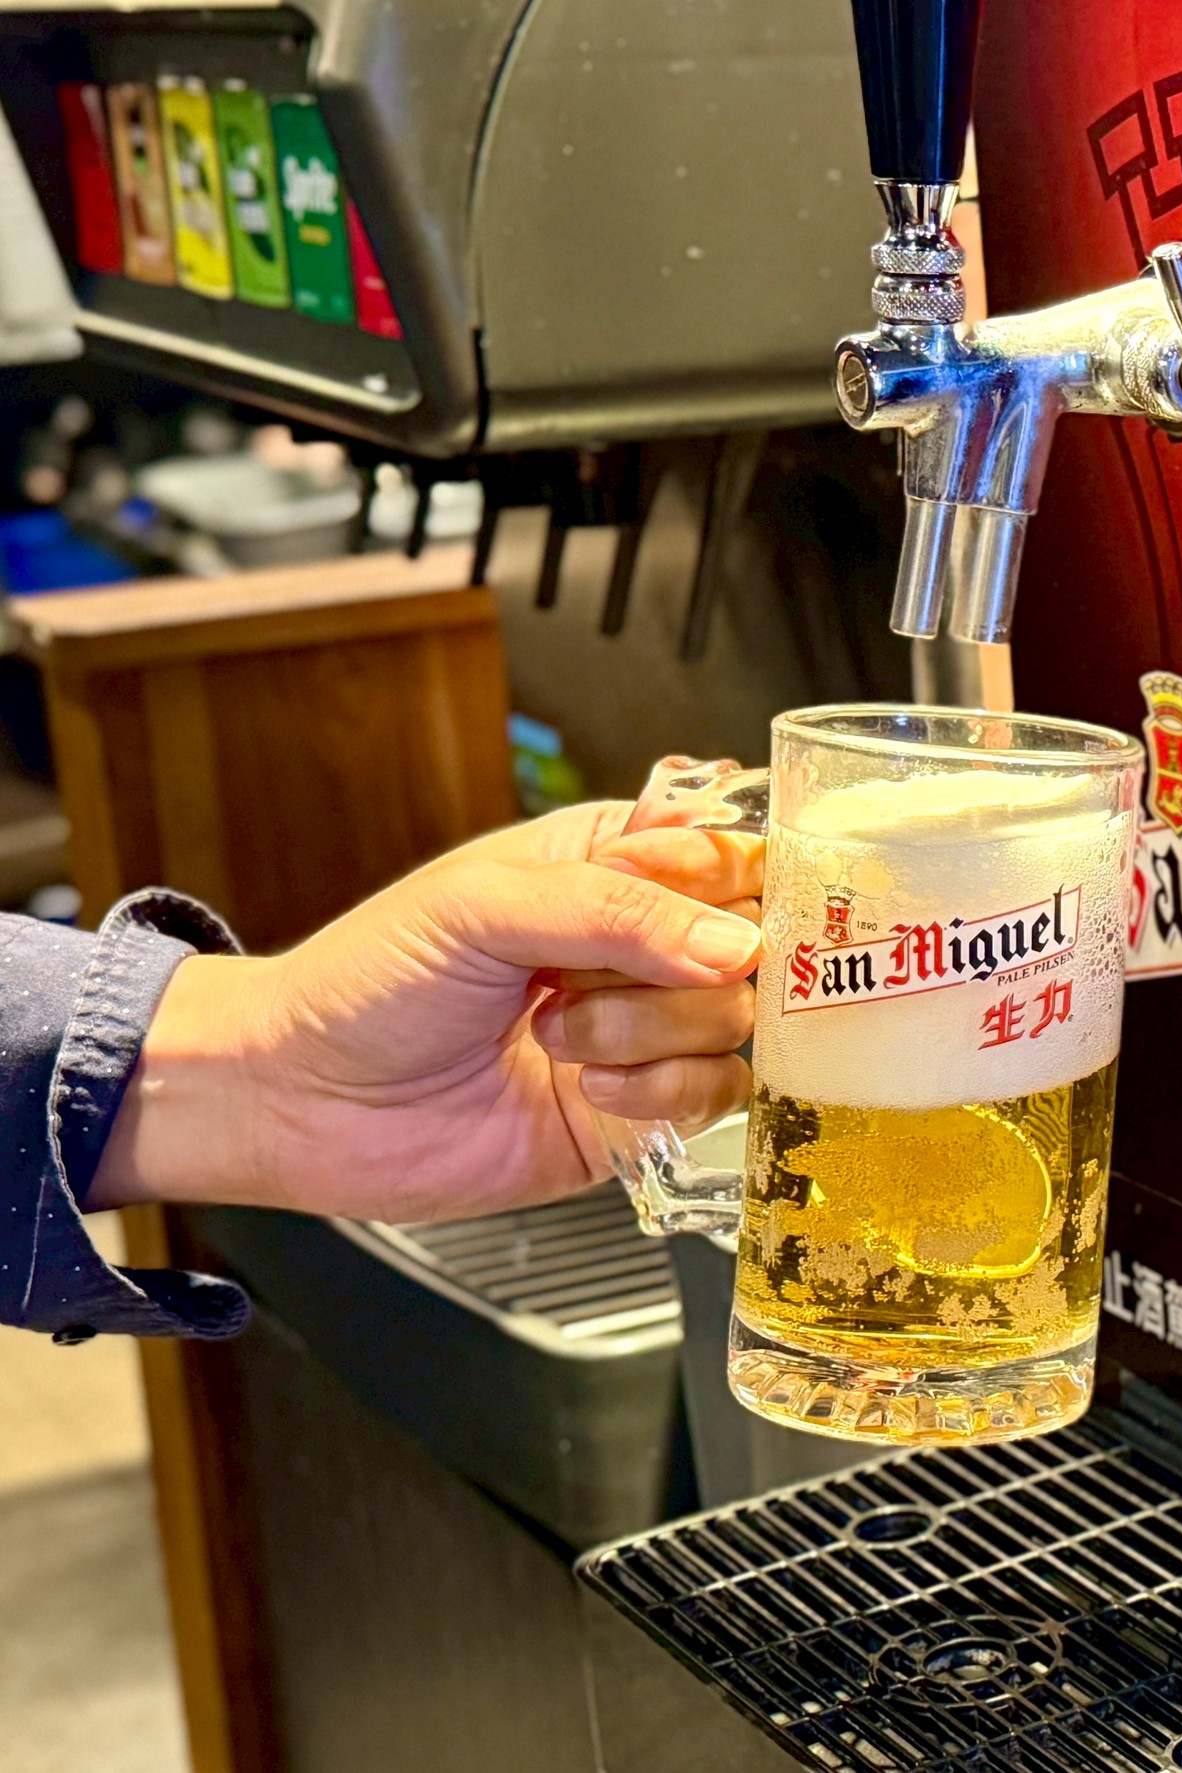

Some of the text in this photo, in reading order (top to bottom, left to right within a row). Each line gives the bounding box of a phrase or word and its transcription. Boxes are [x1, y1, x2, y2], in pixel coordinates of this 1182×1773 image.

[789, 884, 1066, 1001] San Miguel
[997, 950, 1075, 986] PALE PILSEN
[978, 979, 1074, 1050] 生力
